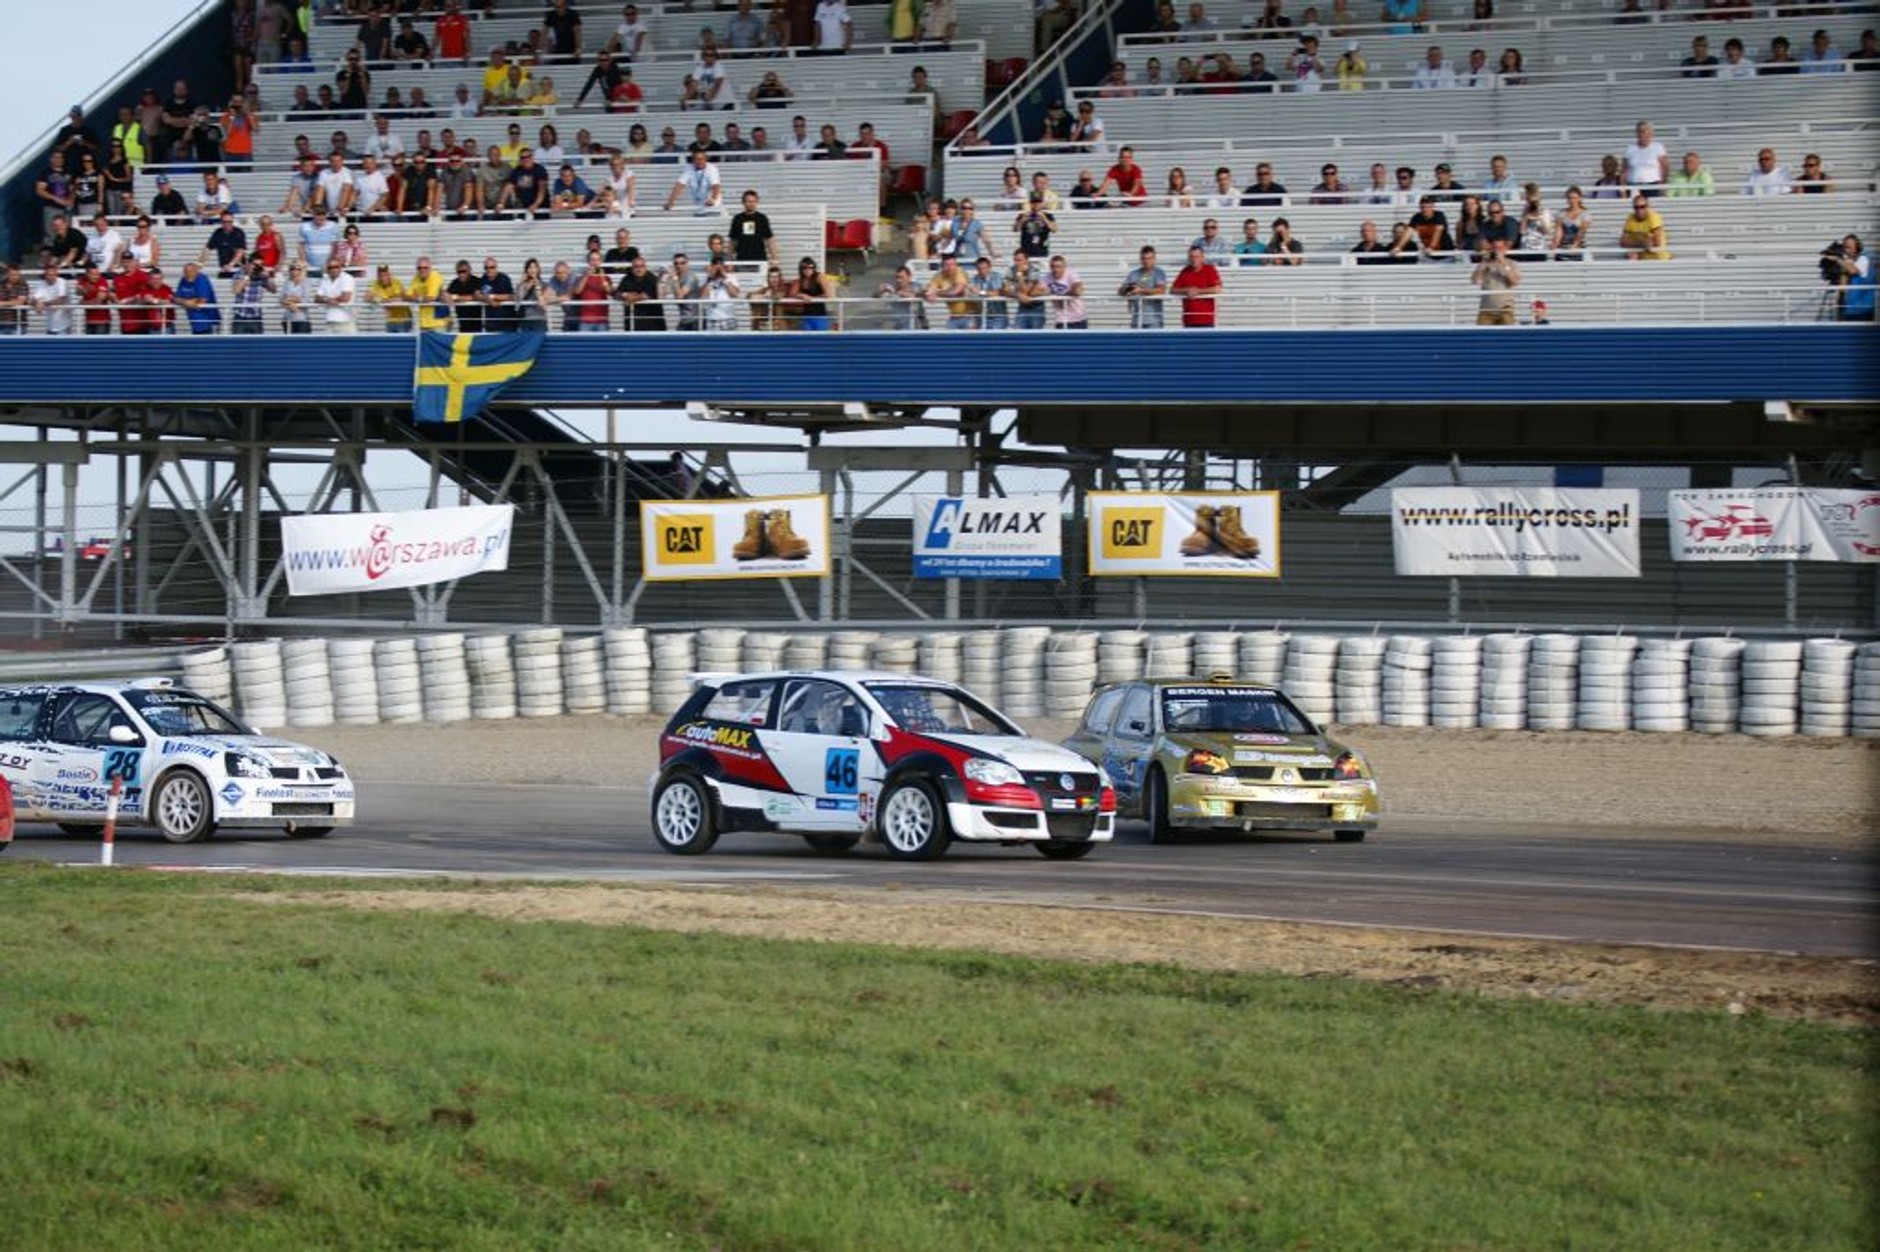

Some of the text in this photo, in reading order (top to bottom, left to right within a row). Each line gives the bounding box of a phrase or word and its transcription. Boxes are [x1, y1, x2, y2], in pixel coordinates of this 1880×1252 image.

[932, 503, 1048, 534] ALMAX
[1112, 519, 1154, 546] CAT
[1400, 501, 1629, 534] www.rallycross.pl
[665, 526, 705, 553] CAT
[1683, 543, 1814, 558] www.rallycross.pl
[104, 751, 141, 781] 28
[826, 754, 858, 788] 46
